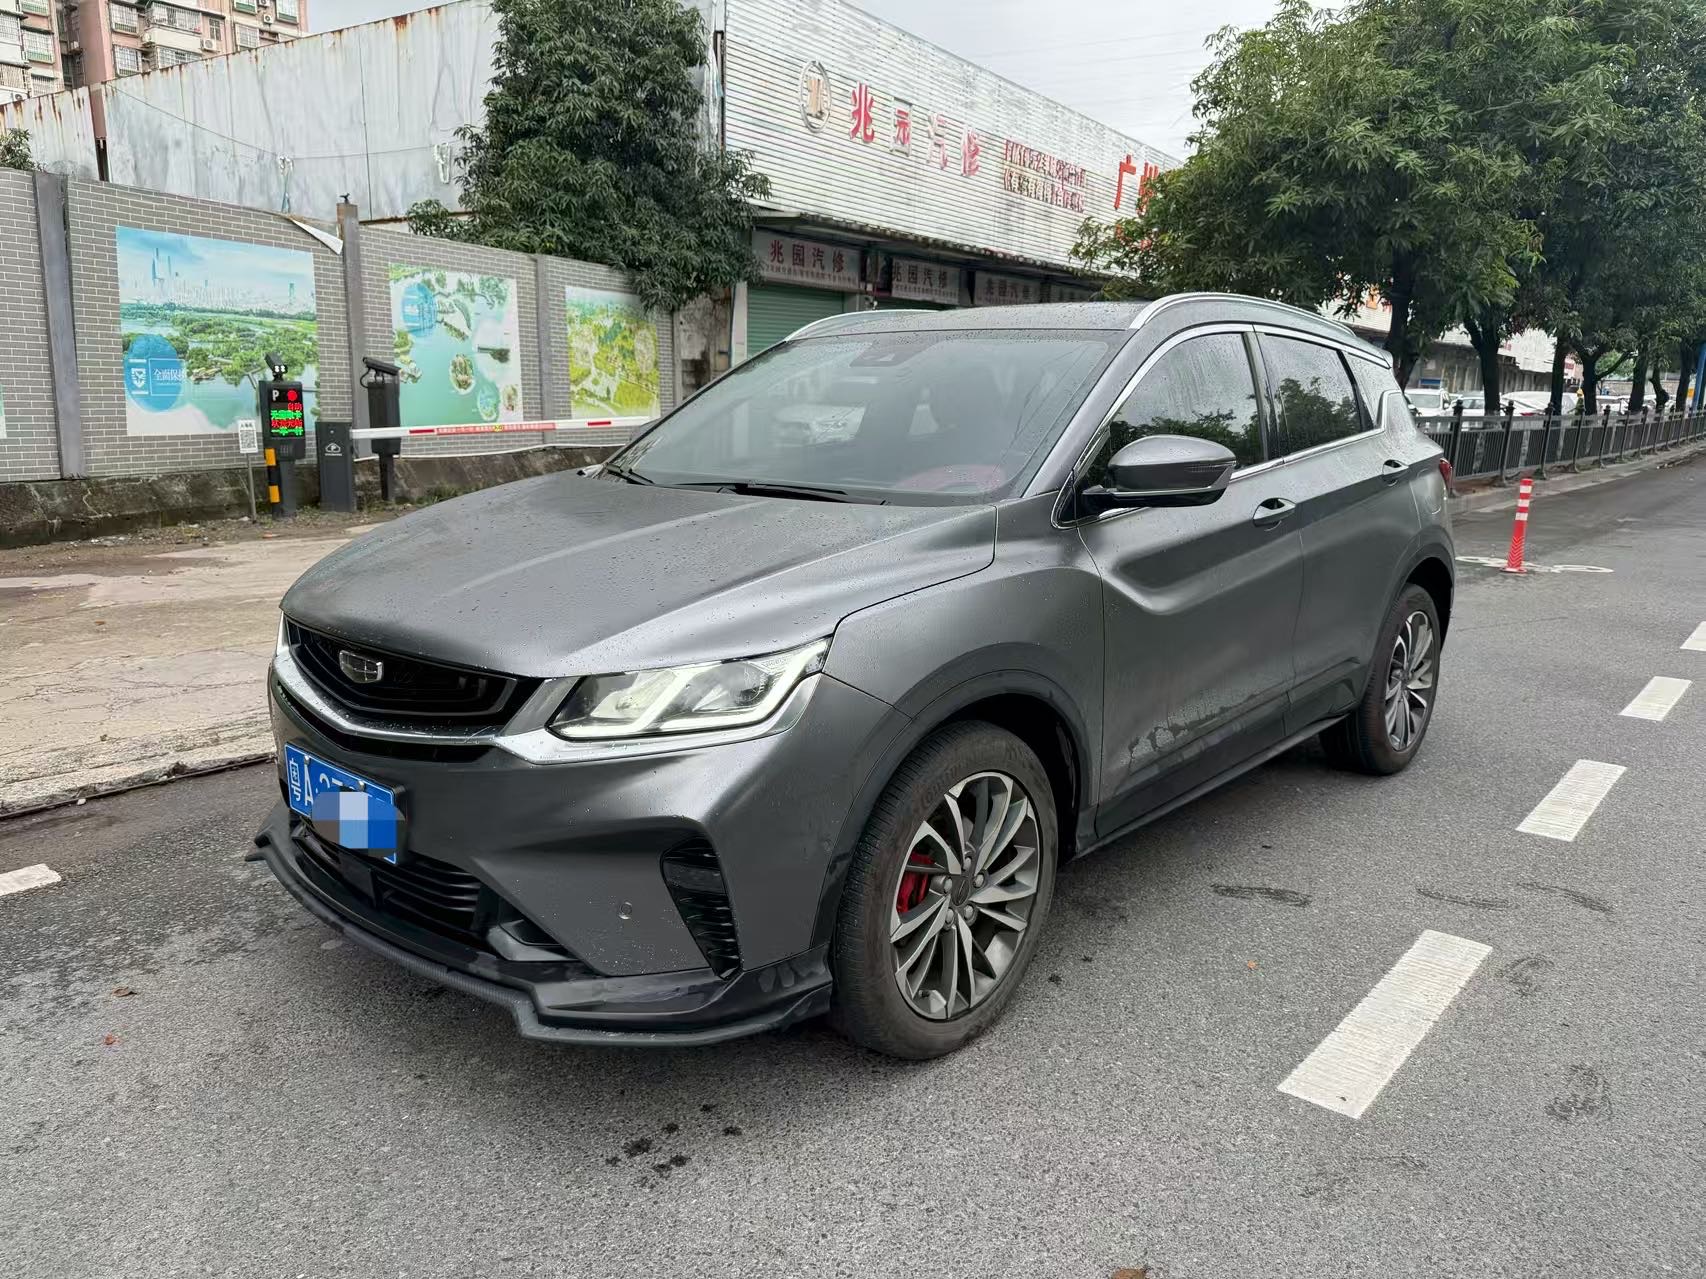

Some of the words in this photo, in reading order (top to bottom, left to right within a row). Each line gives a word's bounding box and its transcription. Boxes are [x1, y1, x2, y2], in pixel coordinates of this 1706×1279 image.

[849, 80, 980, 177] 兆园汽修
[770, 239, 844, 273] 兆园汽修
[272, 389, 280, 401] P
